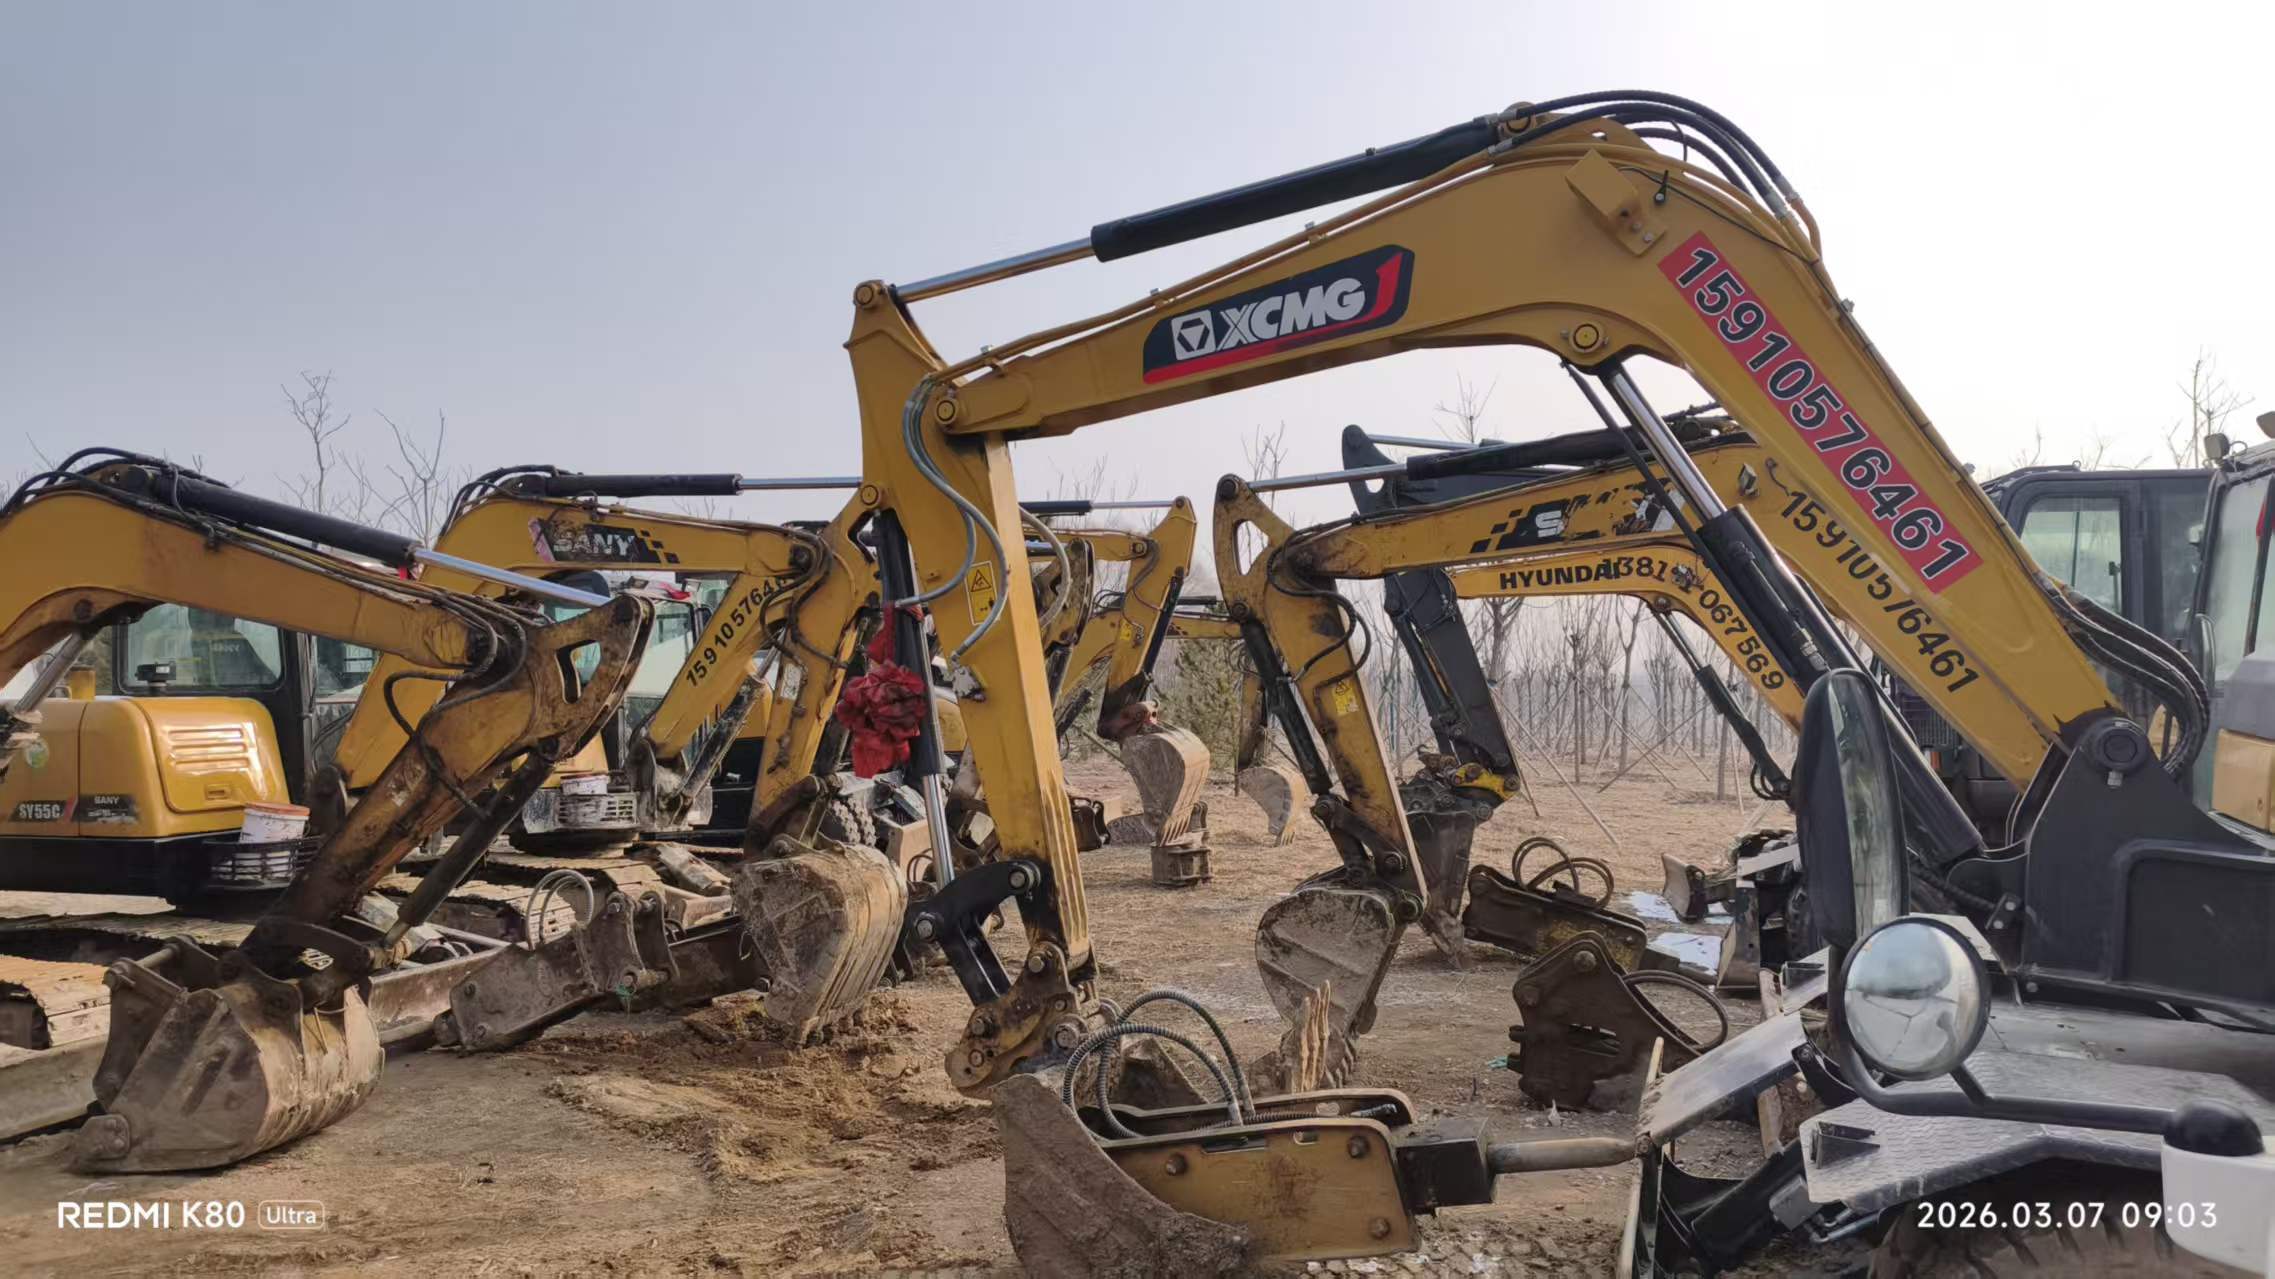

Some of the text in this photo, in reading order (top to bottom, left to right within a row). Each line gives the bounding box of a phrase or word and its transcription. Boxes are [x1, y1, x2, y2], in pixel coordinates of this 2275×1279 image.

[1217, 278, 1365, 351] XCMG
[1676, 247, 1968, 580] 15910576461
[553, 531, 635, 557] SANY
[19, 804, 61, 819] SY55C
